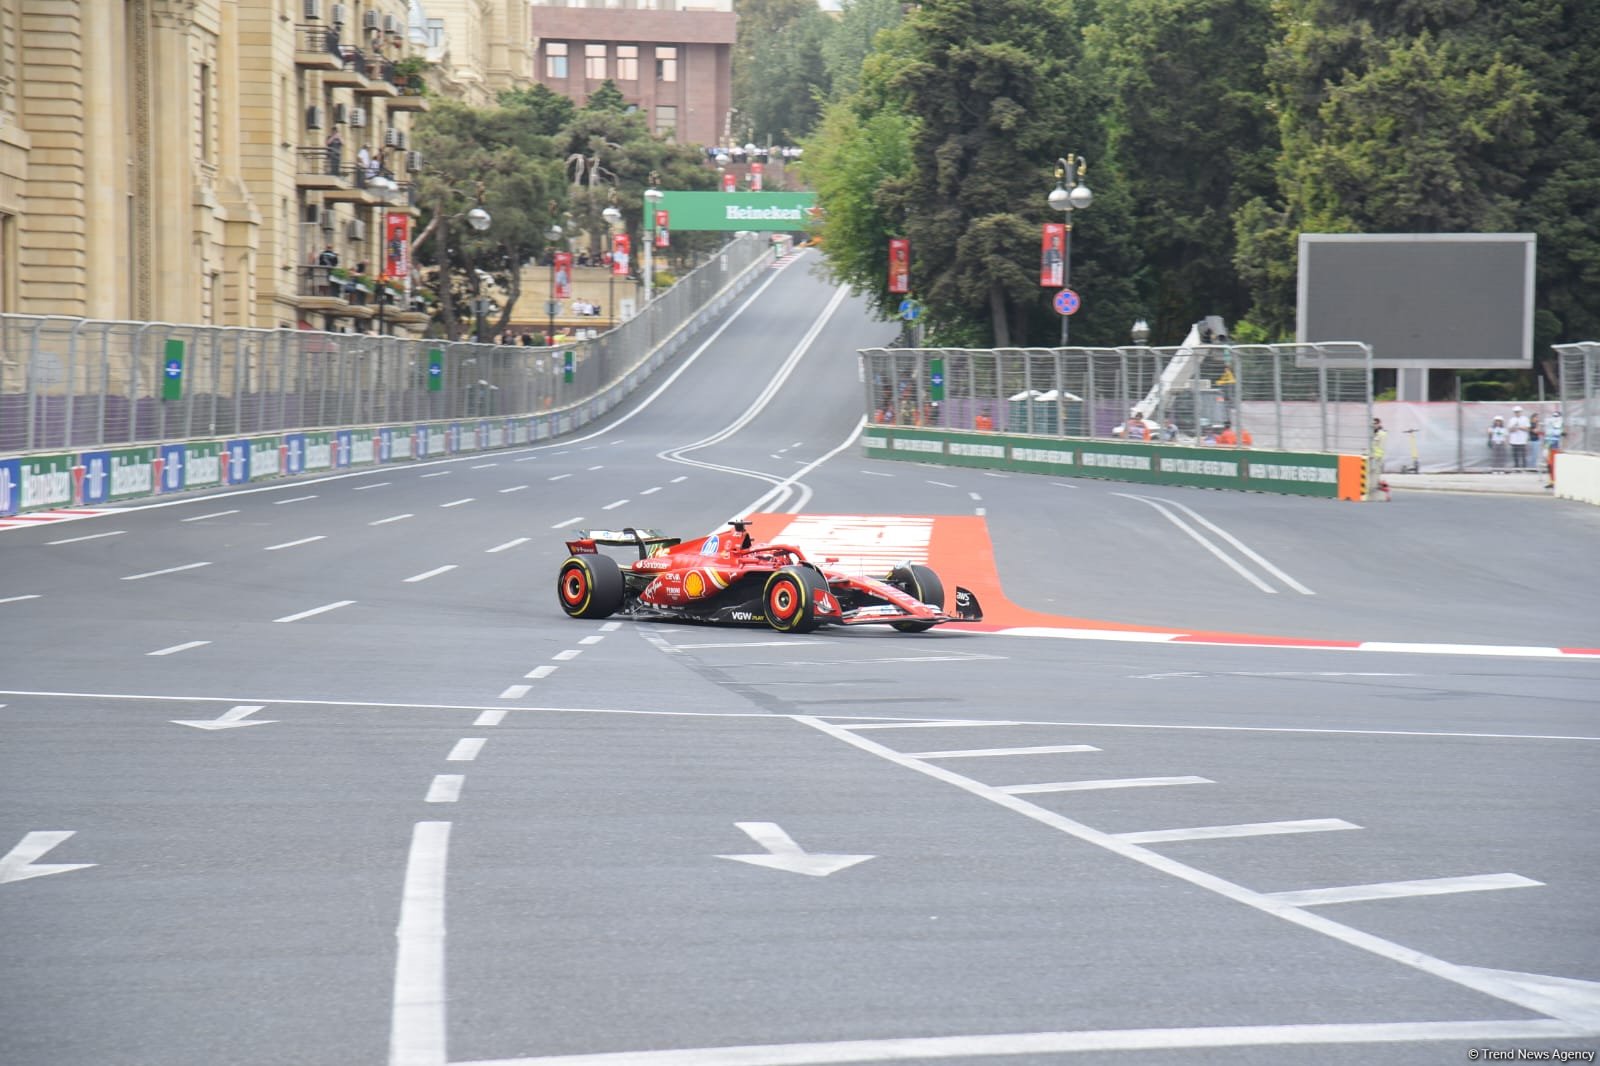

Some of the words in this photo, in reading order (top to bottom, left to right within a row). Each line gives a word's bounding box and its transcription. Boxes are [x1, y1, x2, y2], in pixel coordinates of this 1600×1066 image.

[725, 205, 801, 220] Heineken
[956, 591, 970, 601] aws
[731, 612, 752, 621] VGW
